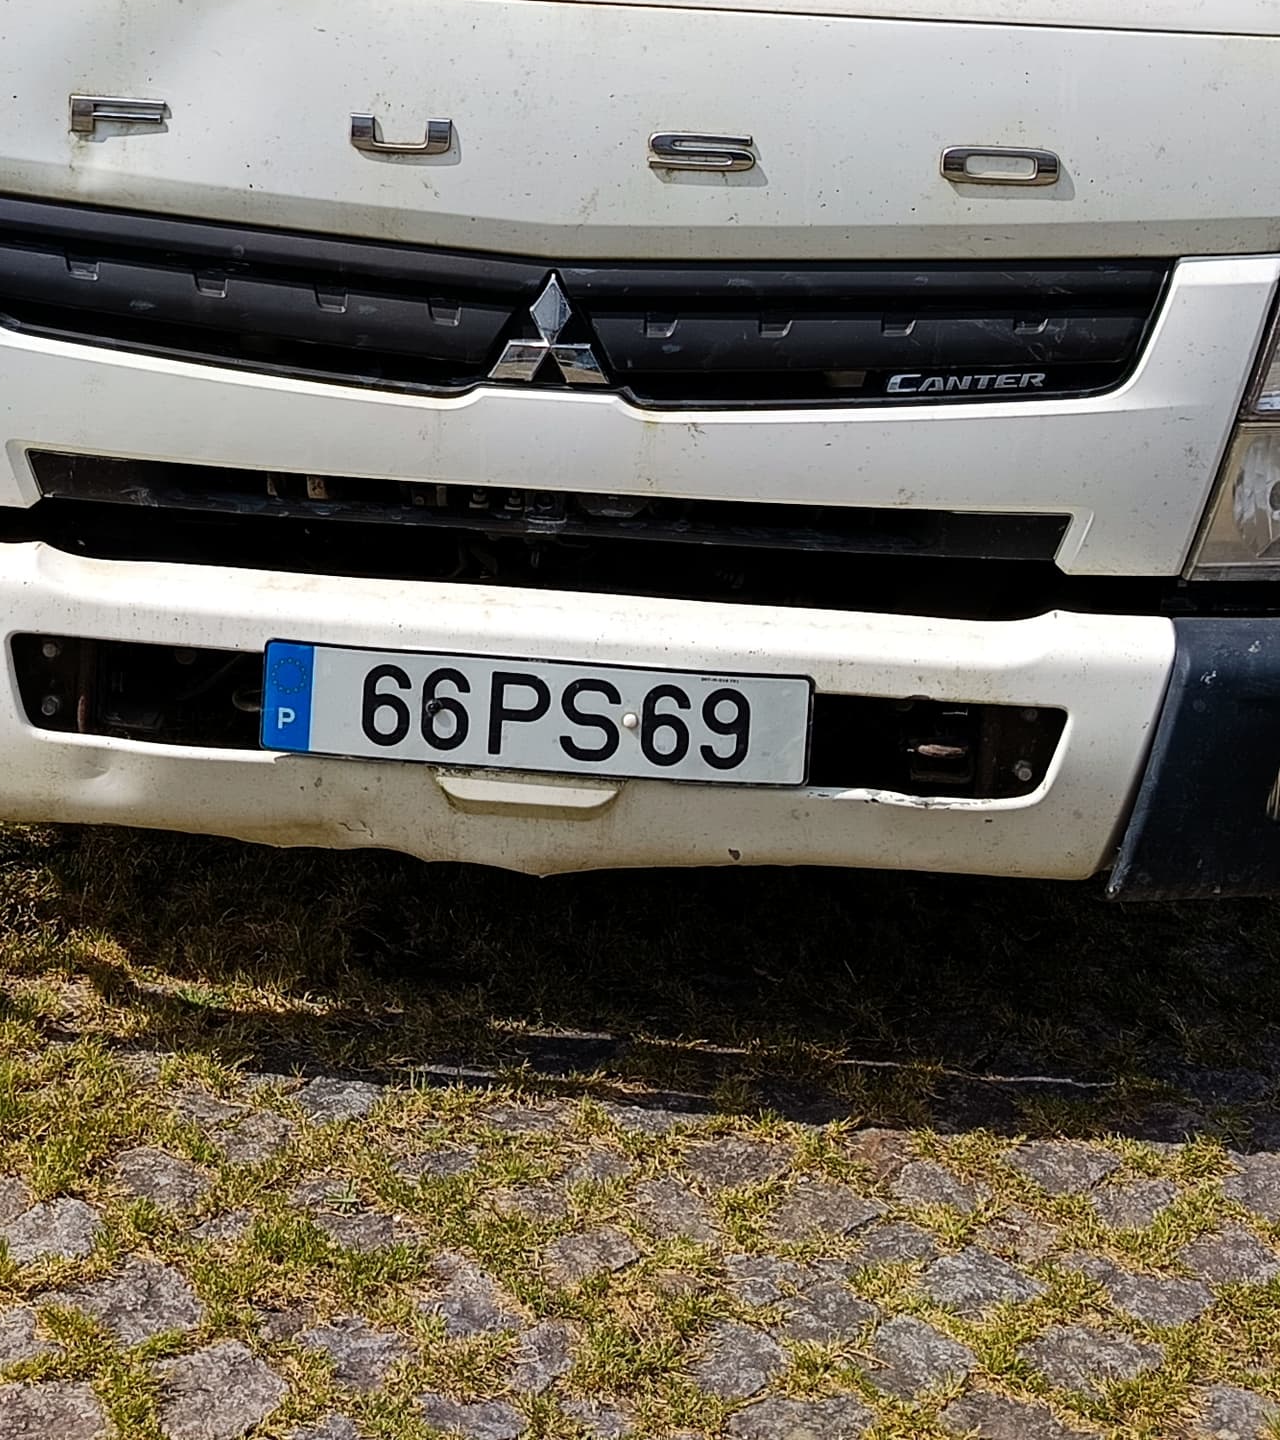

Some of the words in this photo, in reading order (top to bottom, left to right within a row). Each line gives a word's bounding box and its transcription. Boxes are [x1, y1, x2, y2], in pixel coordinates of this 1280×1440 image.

[69, 93, 1061, 186] FUSO
[277, 707, 296, 729] P
[361, 664, 751, 770] 66PS69
